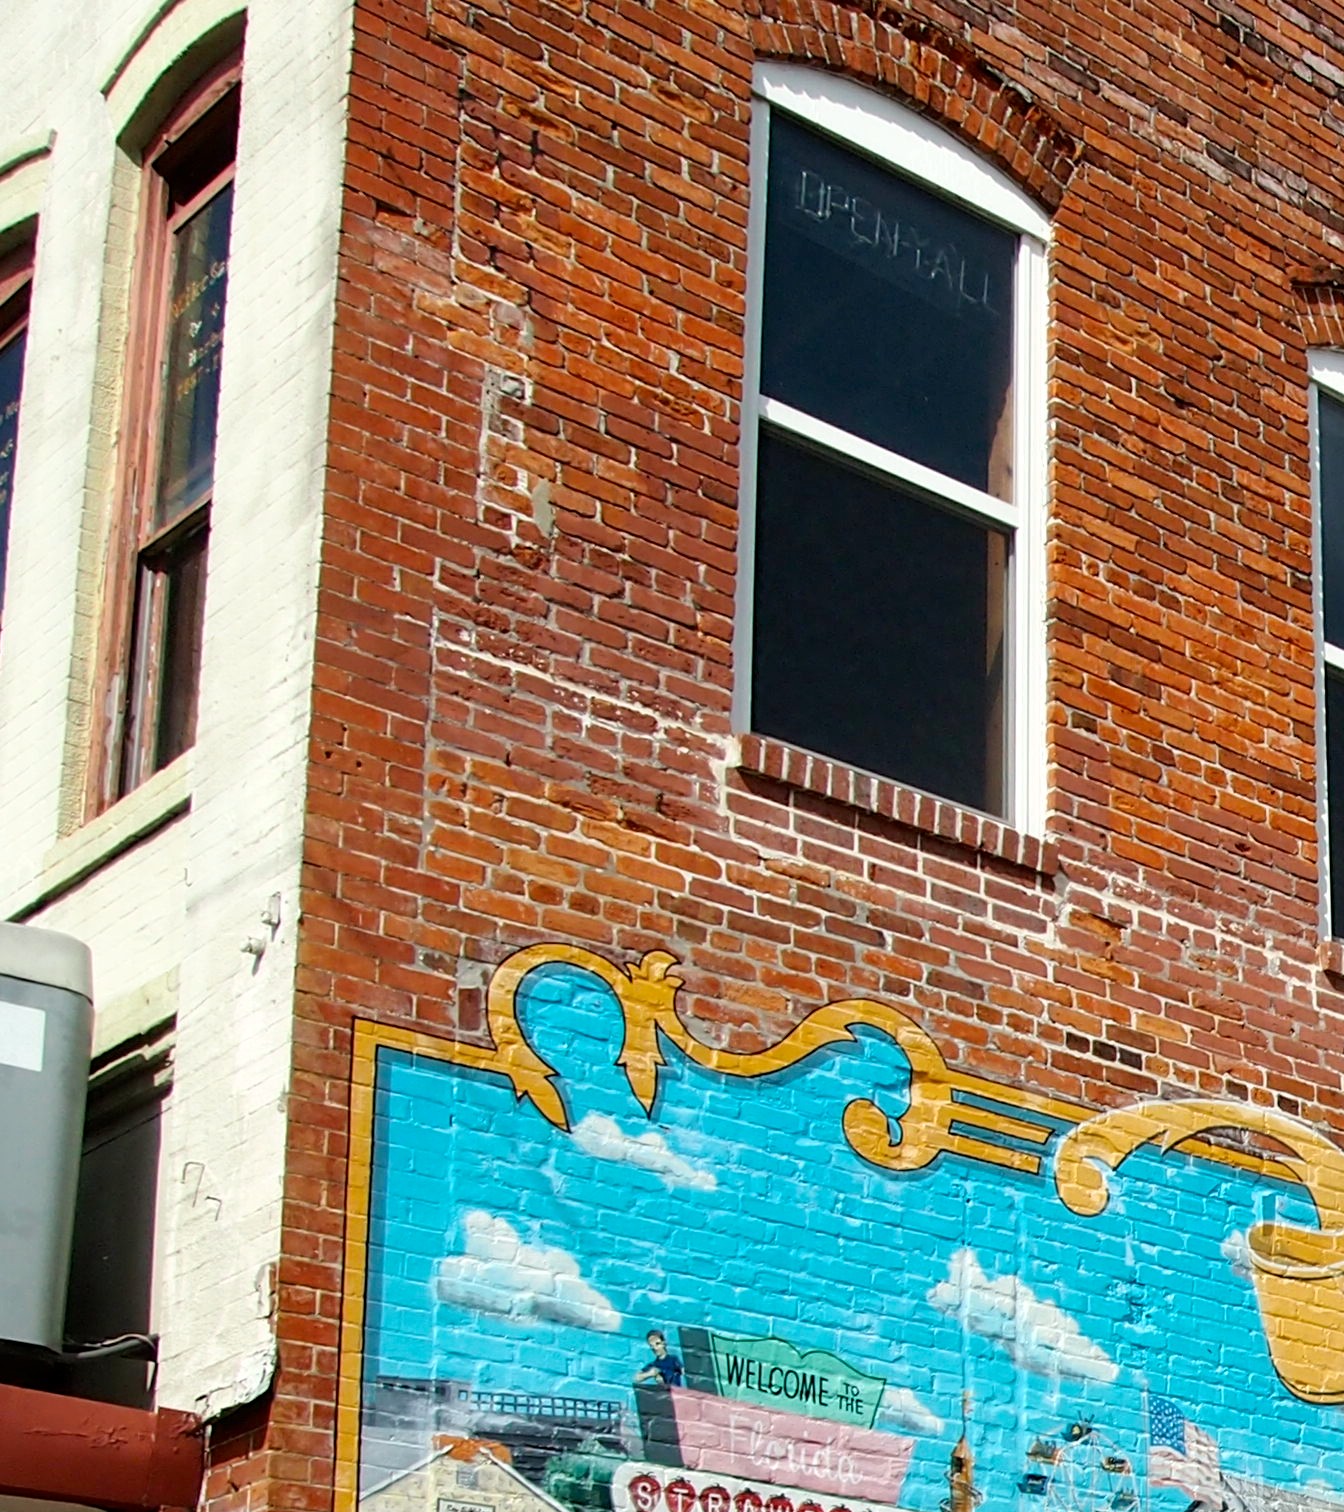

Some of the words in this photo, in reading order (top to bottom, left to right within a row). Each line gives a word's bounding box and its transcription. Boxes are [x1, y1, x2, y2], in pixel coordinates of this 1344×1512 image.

[726, 1353, 829, 1407] WELCOME
[843, 1383, 860, 1396] TO
[837, 1394, 864, 1415] THE
[729, 1414, 864, 1485] Florida
